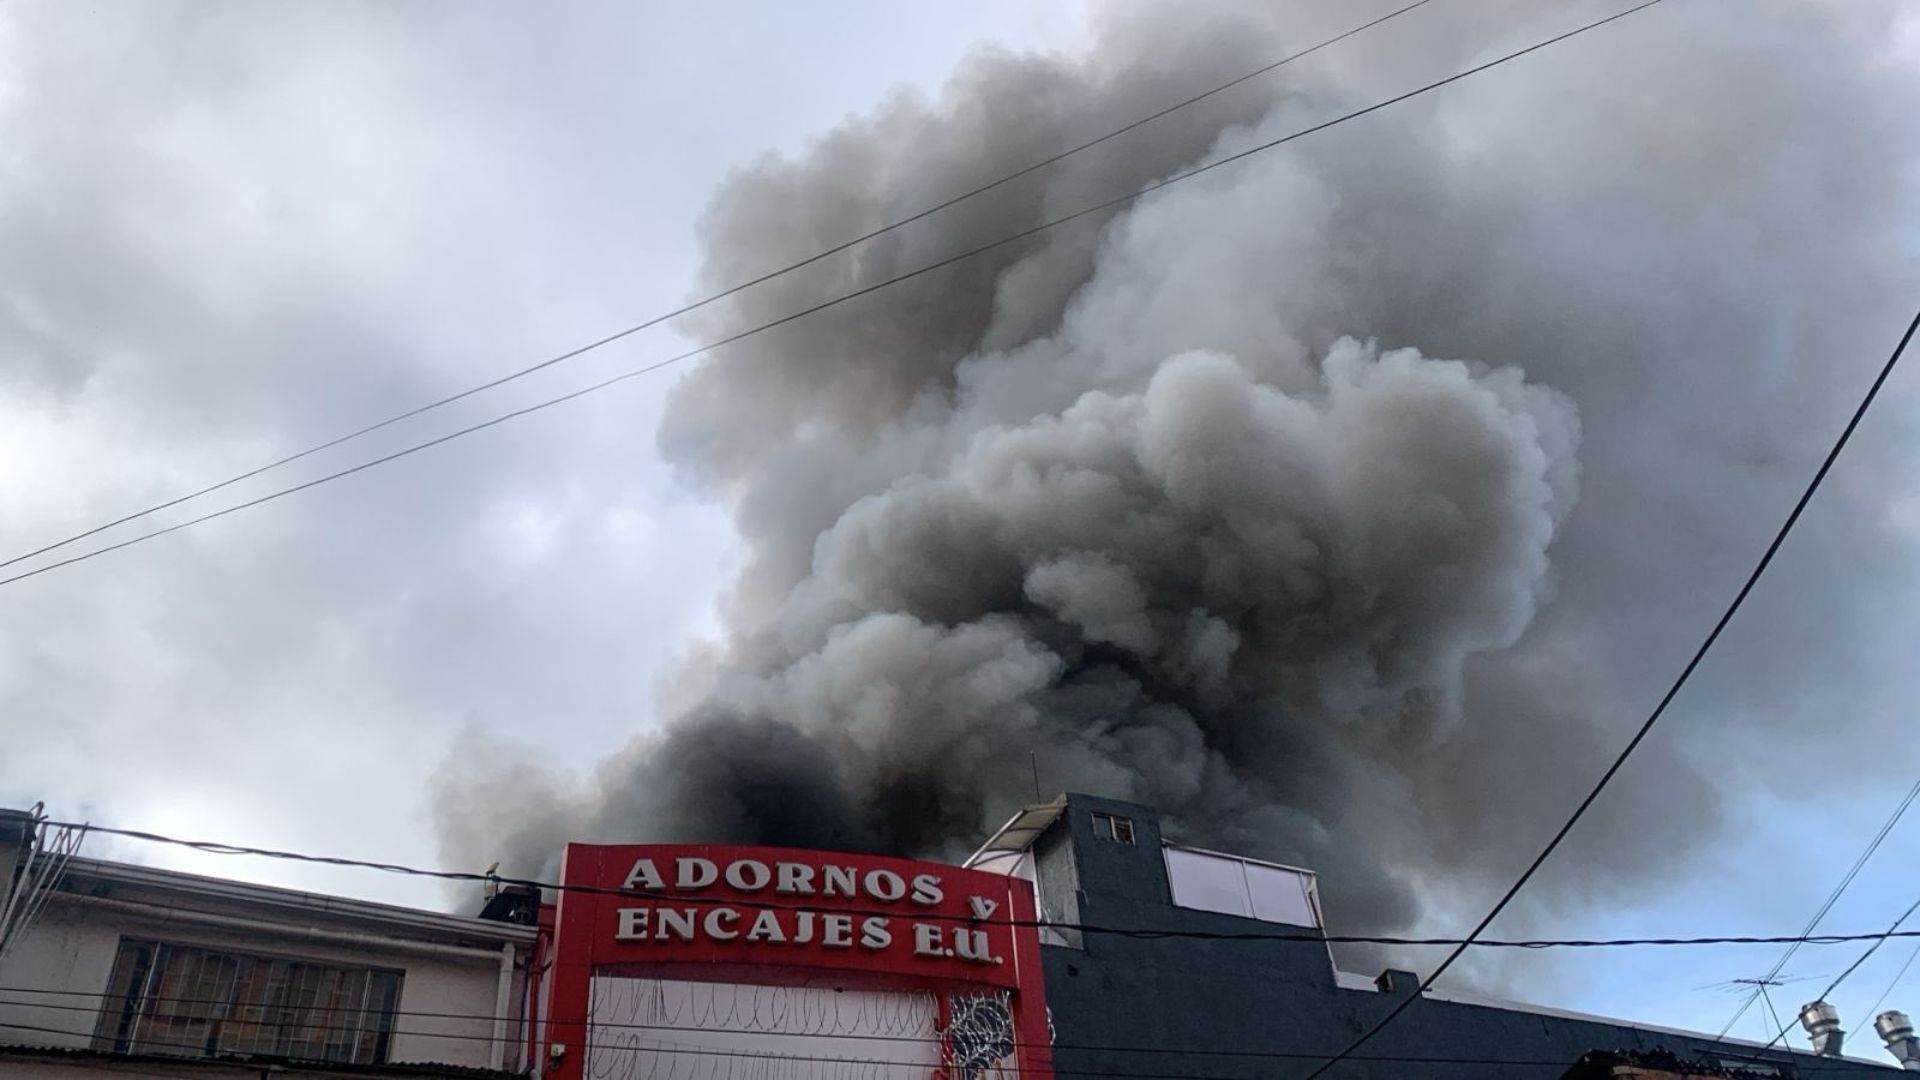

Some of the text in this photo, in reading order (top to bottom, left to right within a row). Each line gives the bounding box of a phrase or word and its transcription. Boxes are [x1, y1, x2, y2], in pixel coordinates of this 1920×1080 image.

[622, 857, 944, 904] ADORNOS
[615, 907, 1004, 964] ENCAJES E.U.
